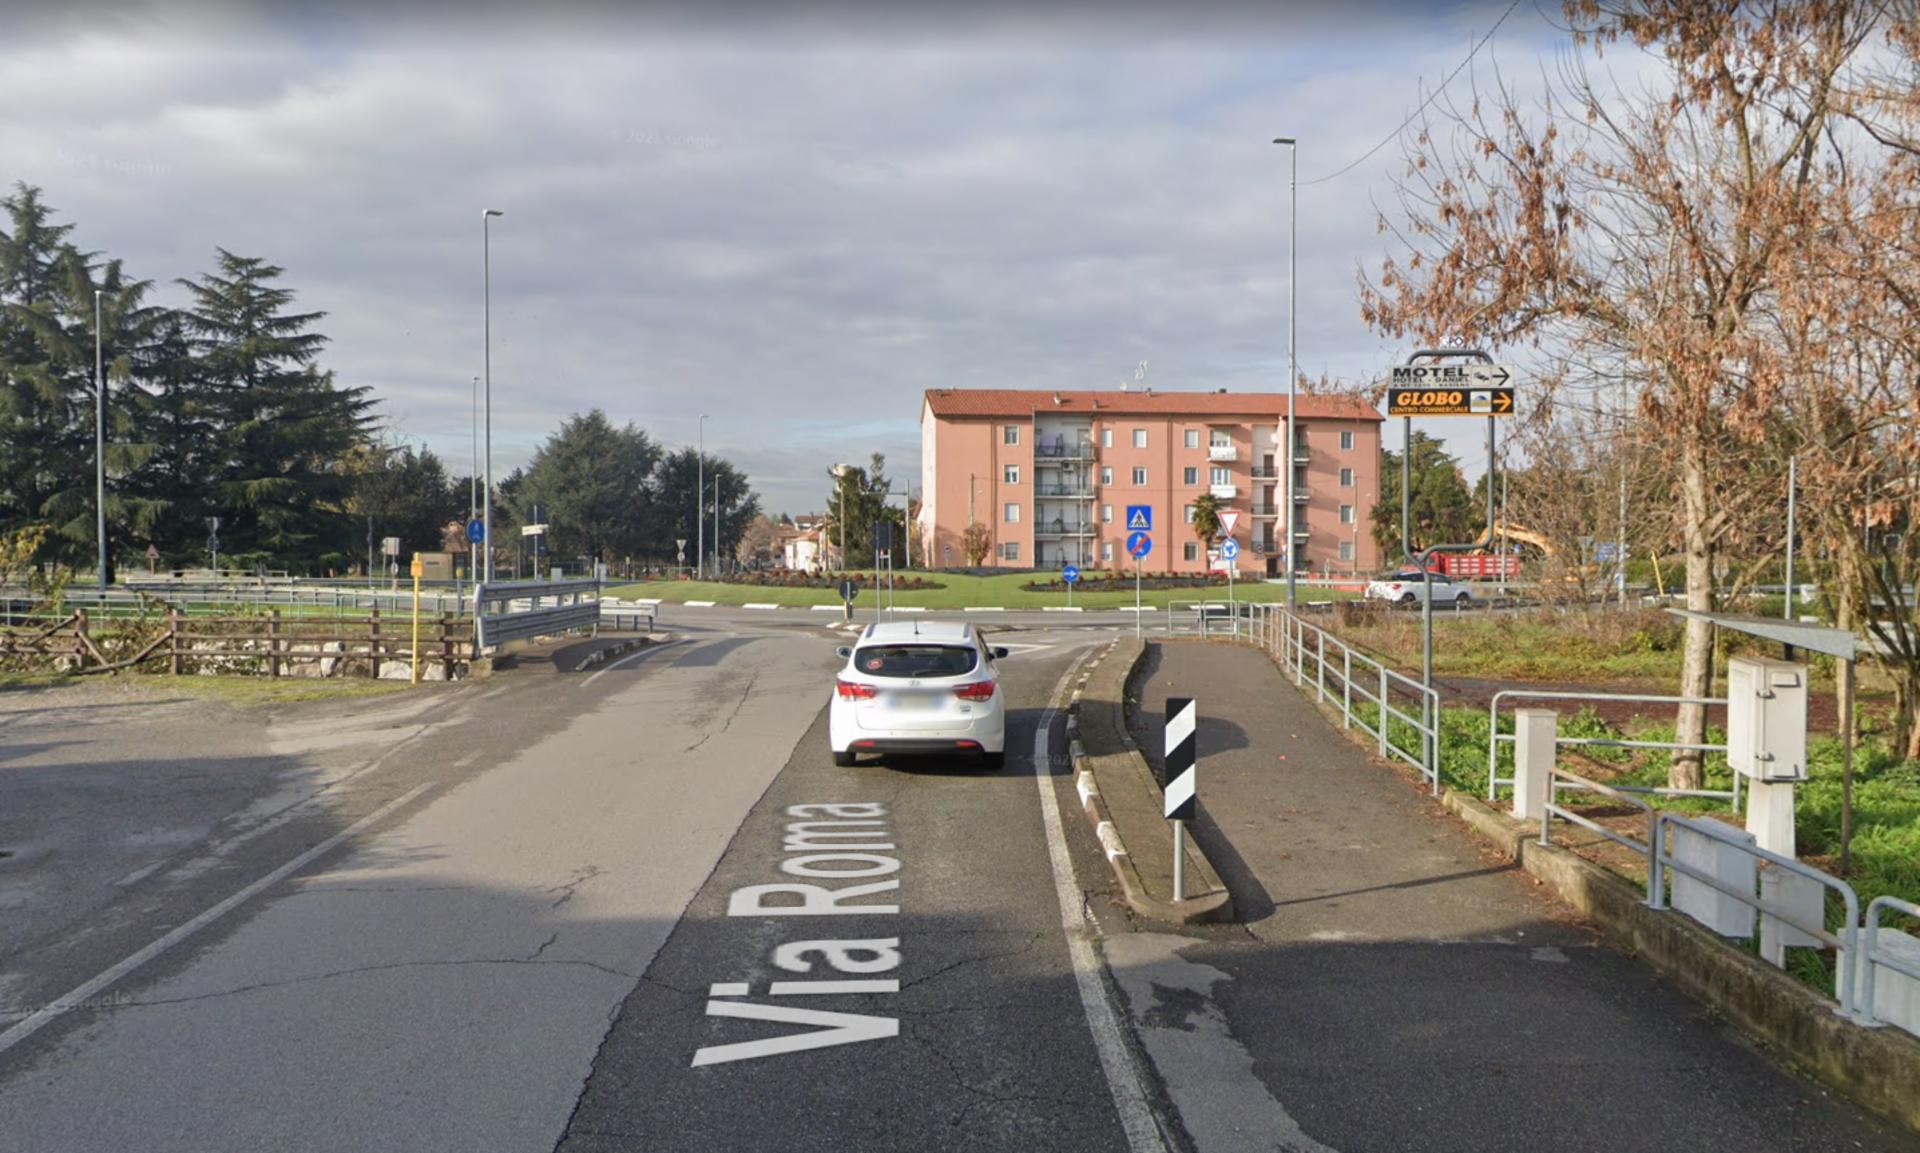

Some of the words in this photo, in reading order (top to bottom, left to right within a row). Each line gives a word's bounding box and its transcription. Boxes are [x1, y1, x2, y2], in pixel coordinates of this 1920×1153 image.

[1393, 367, 1470, 377] MOTEL
[1393, 376, 1423, 384] HOTEL
[1396, 391, 1463, 406] GLOBO
[1420, 405, 1469, 413] COMMERCIALE
[727, 802, 902, 917] Roma
[690, 937, 901, 1068] Via
